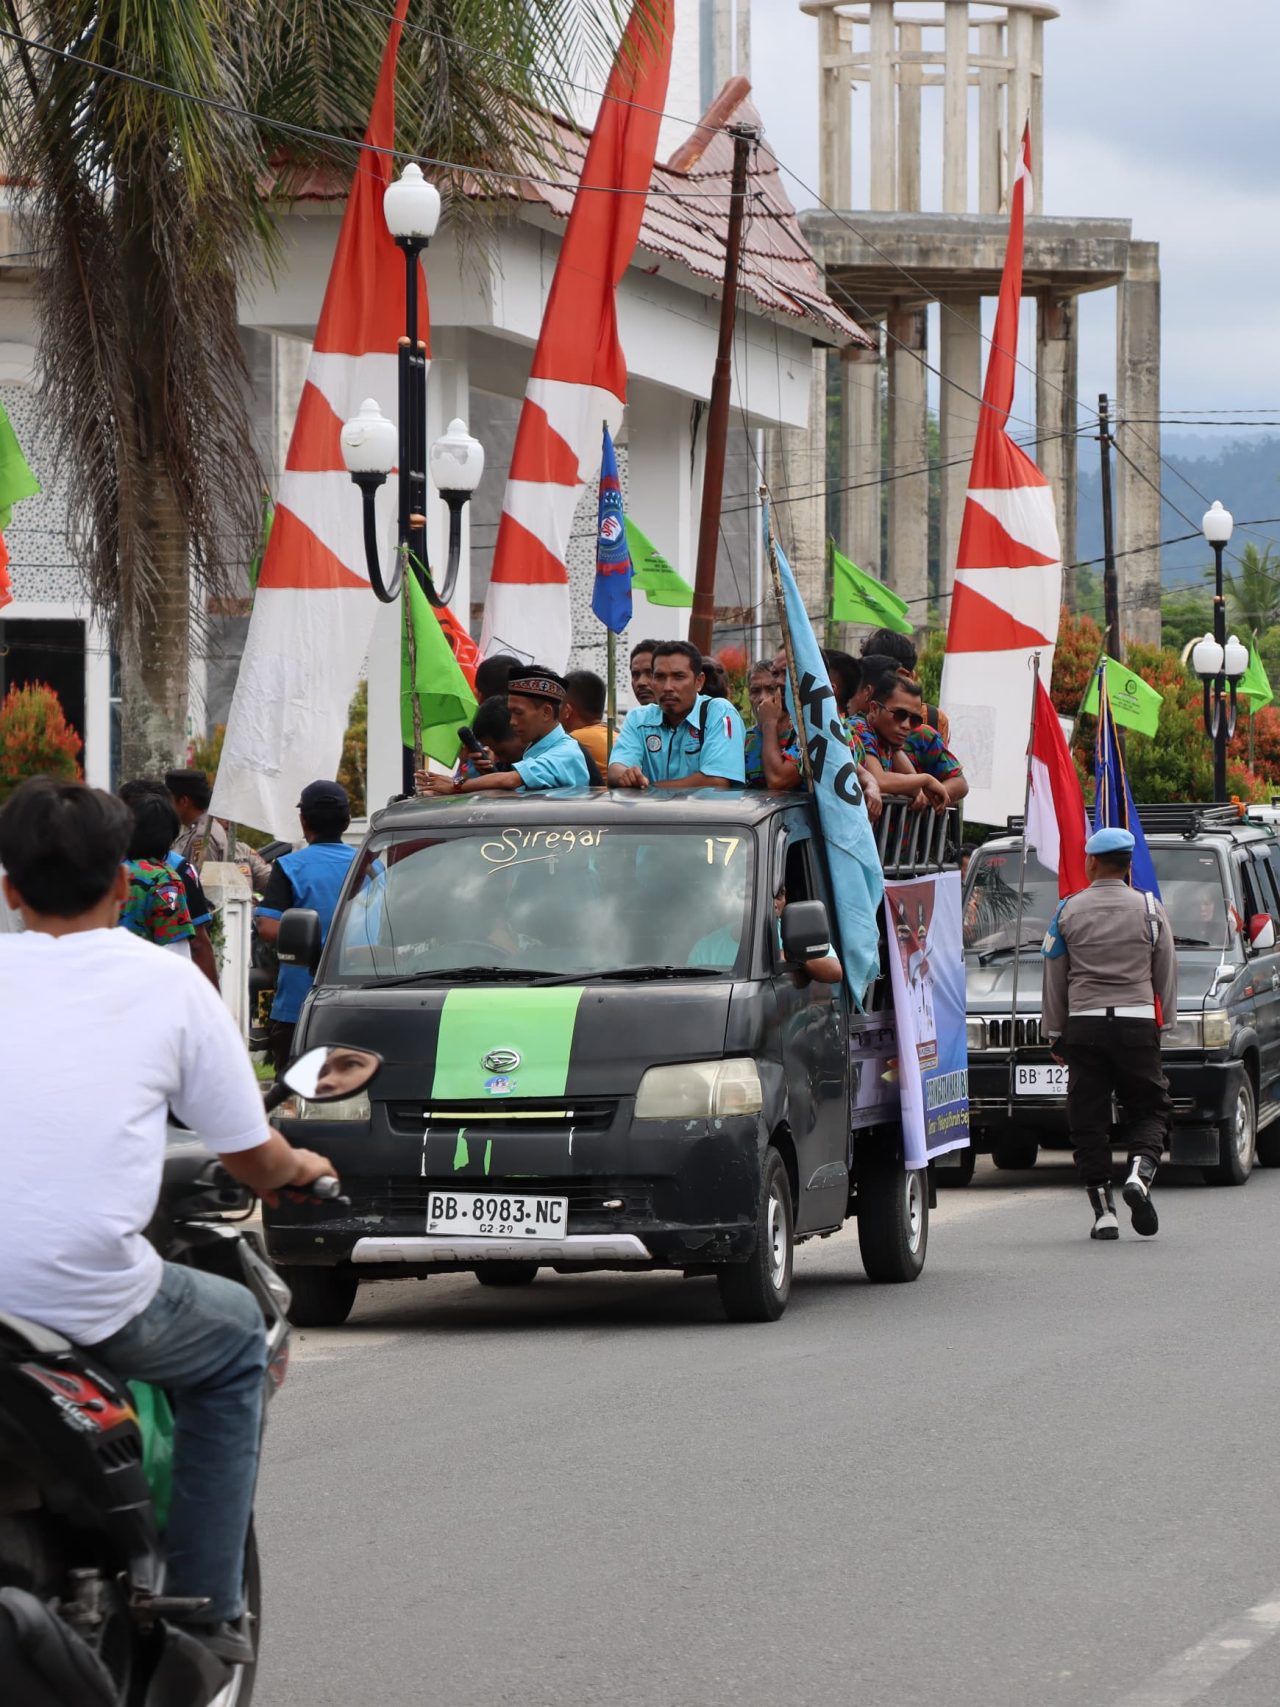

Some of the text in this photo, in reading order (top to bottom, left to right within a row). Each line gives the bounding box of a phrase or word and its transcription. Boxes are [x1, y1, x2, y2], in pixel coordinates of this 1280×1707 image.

[481, 828, 609, 863] Siregar
[704, 837, 739, 866] 17
[1019, 1069, 1037, 1084] BB
[431, 1196, 562, 1224] BB 8983 NC
